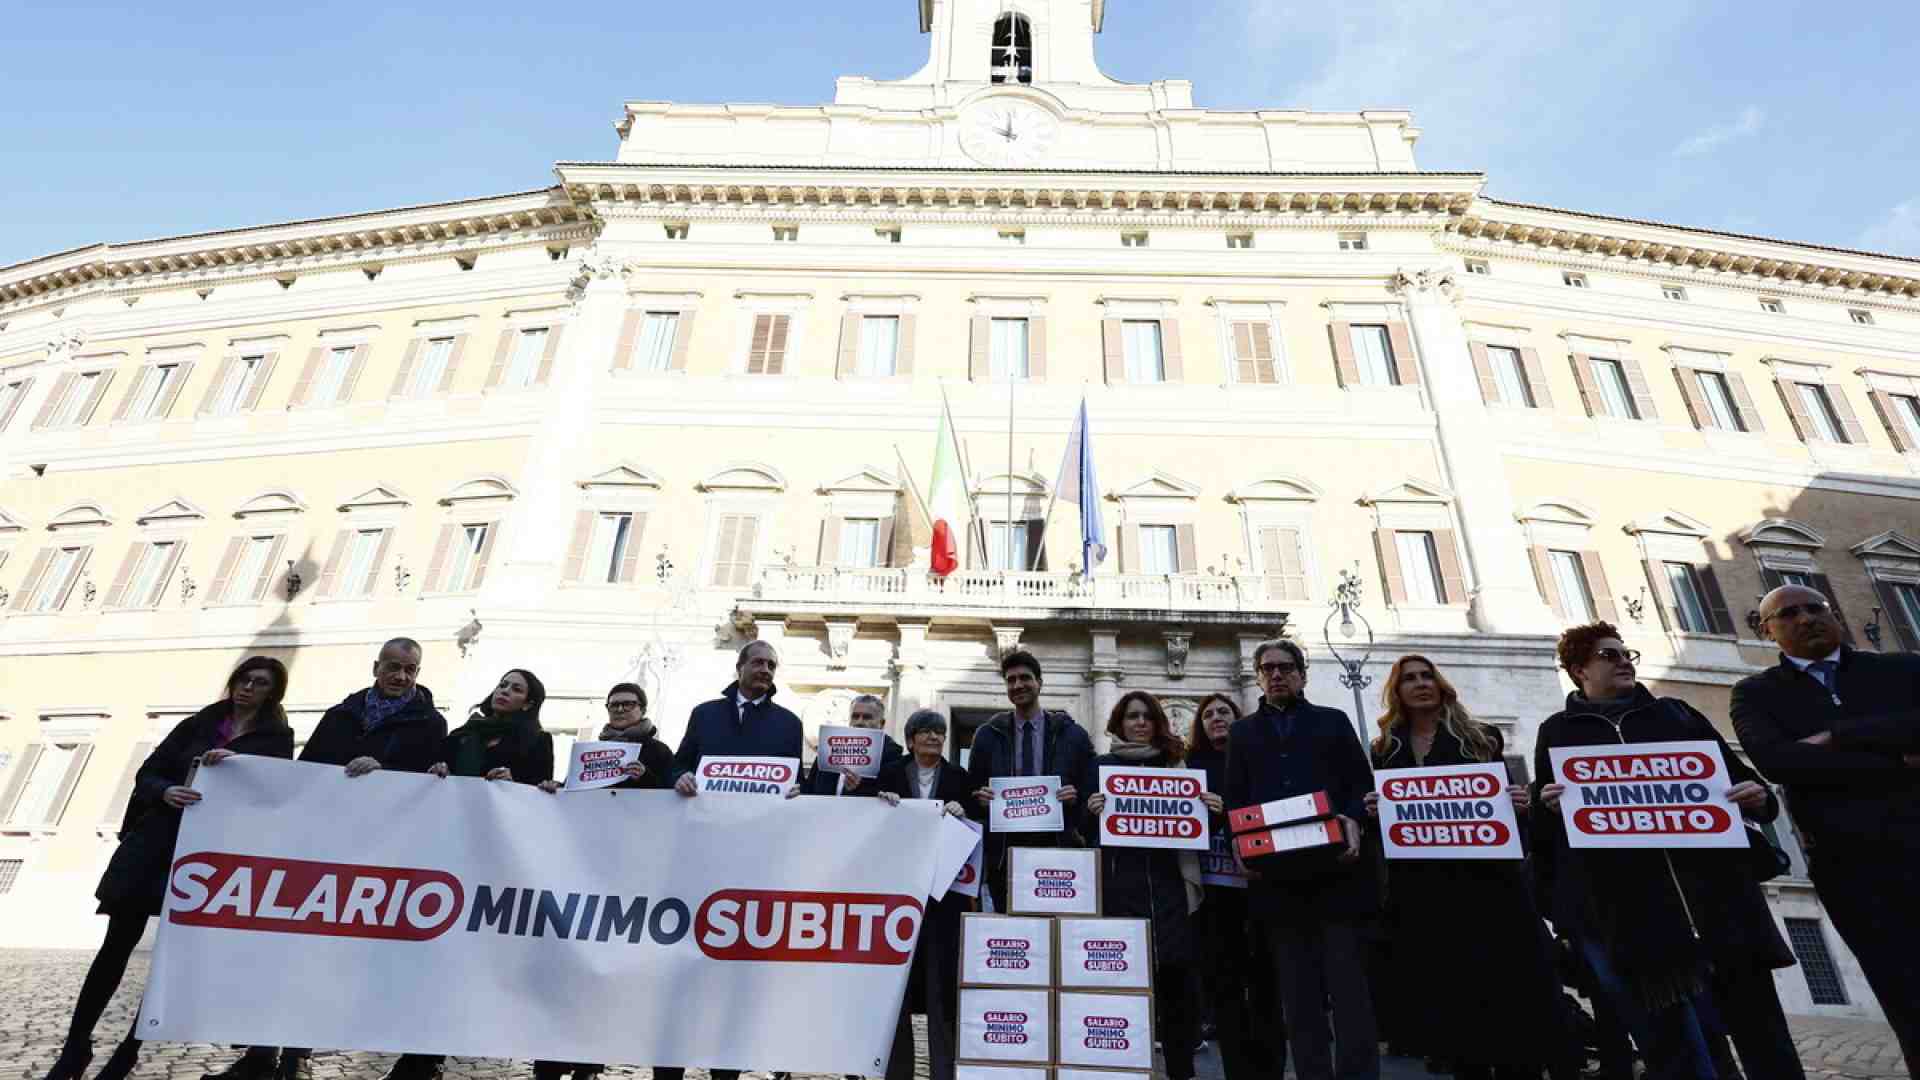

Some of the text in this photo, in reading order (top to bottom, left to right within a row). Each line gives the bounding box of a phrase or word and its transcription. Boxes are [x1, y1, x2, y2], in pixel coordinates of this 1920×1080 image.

[831, 737, 869, 746] SALARIO
[831, 747, 868, 755] MINIMO
[831, 756, 869, 765] SUBITO
[709, 763, 785, 780] SALARIO
[1573, 756, 1705, 780] SALARIO
[705, 779, 781, 795] MINIMO
[1004, 786, 1045, 798] SALARIO
[1113, 777, 1194, 796] SALARIO
[1390, 776, 1491, 798] SALARIO
[1580, 783, 1709, 805] MINIMO
[1006, 796, 1046, 807] MINIMO
[1115, 798, 1193, 816] MINIMO
[1007, 805, 1048, 817] SUBITO
[1395, 801, 1494, 820] MINIMO
[1588, 809, 1714, 832] SUBITO
[1116, 817, 1193, 836] SUBITO
[1400, 824, 1497, 844] SUBITO
[170, 861, 923, 953] SALARIO MINIMO SUBITO
[989, 940, 1026, 950] SALARIO
[1087, 941, 1124, 951] SALARIO
[989, 950, 1026, 958] MINIMO
[1087, 951, 1124, 960] MINIMO
[989, 958, 1026, 968] SUBITO
[1088, 960, 1125, 970] SUBITO
[986, 1012, 1025, 1023] SALARIO
[1087, 1017, 1125, 1028] SALARIO
[986, 1023, 1025, 1032] MINIMO
[1087, 1028, 1126, 1037] MINIMO
[986, 1032, 1025, 1043] SUBITO
[1087, 1038, 1126, 1048] SUBITO
